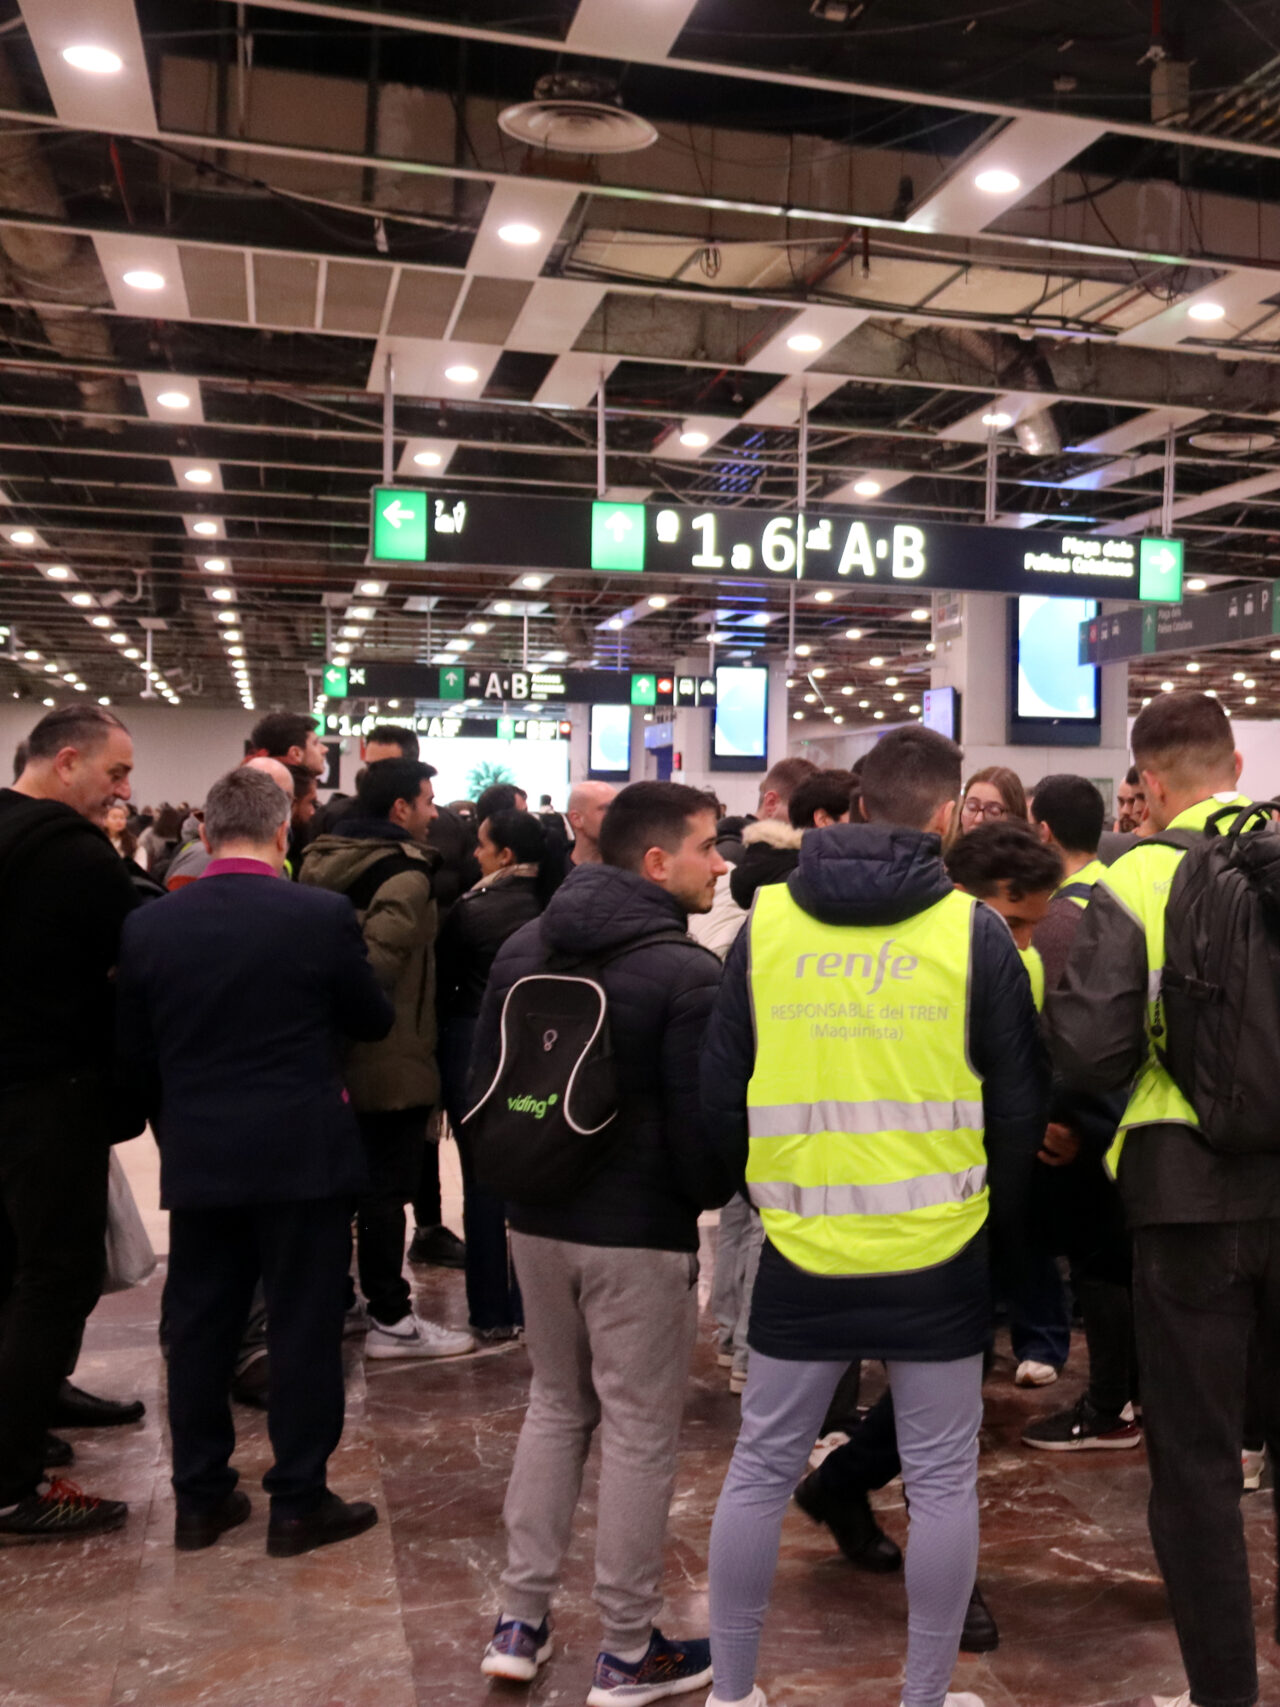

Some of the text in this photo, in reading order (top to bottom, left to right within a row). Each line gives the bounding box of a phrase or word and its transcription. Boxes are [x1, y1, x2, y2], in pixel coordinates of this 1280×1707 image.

[691, 512, 724, 568] 1
[761, 517, 796, 572] 6
[794, 938, 919, 996] renfe
[770, 1002, 948, 1021] RESPONSABLE del TREN
[809, 1023, 905, 1041] (Maquinista)
[507, 1094, 548, 1120] viding
